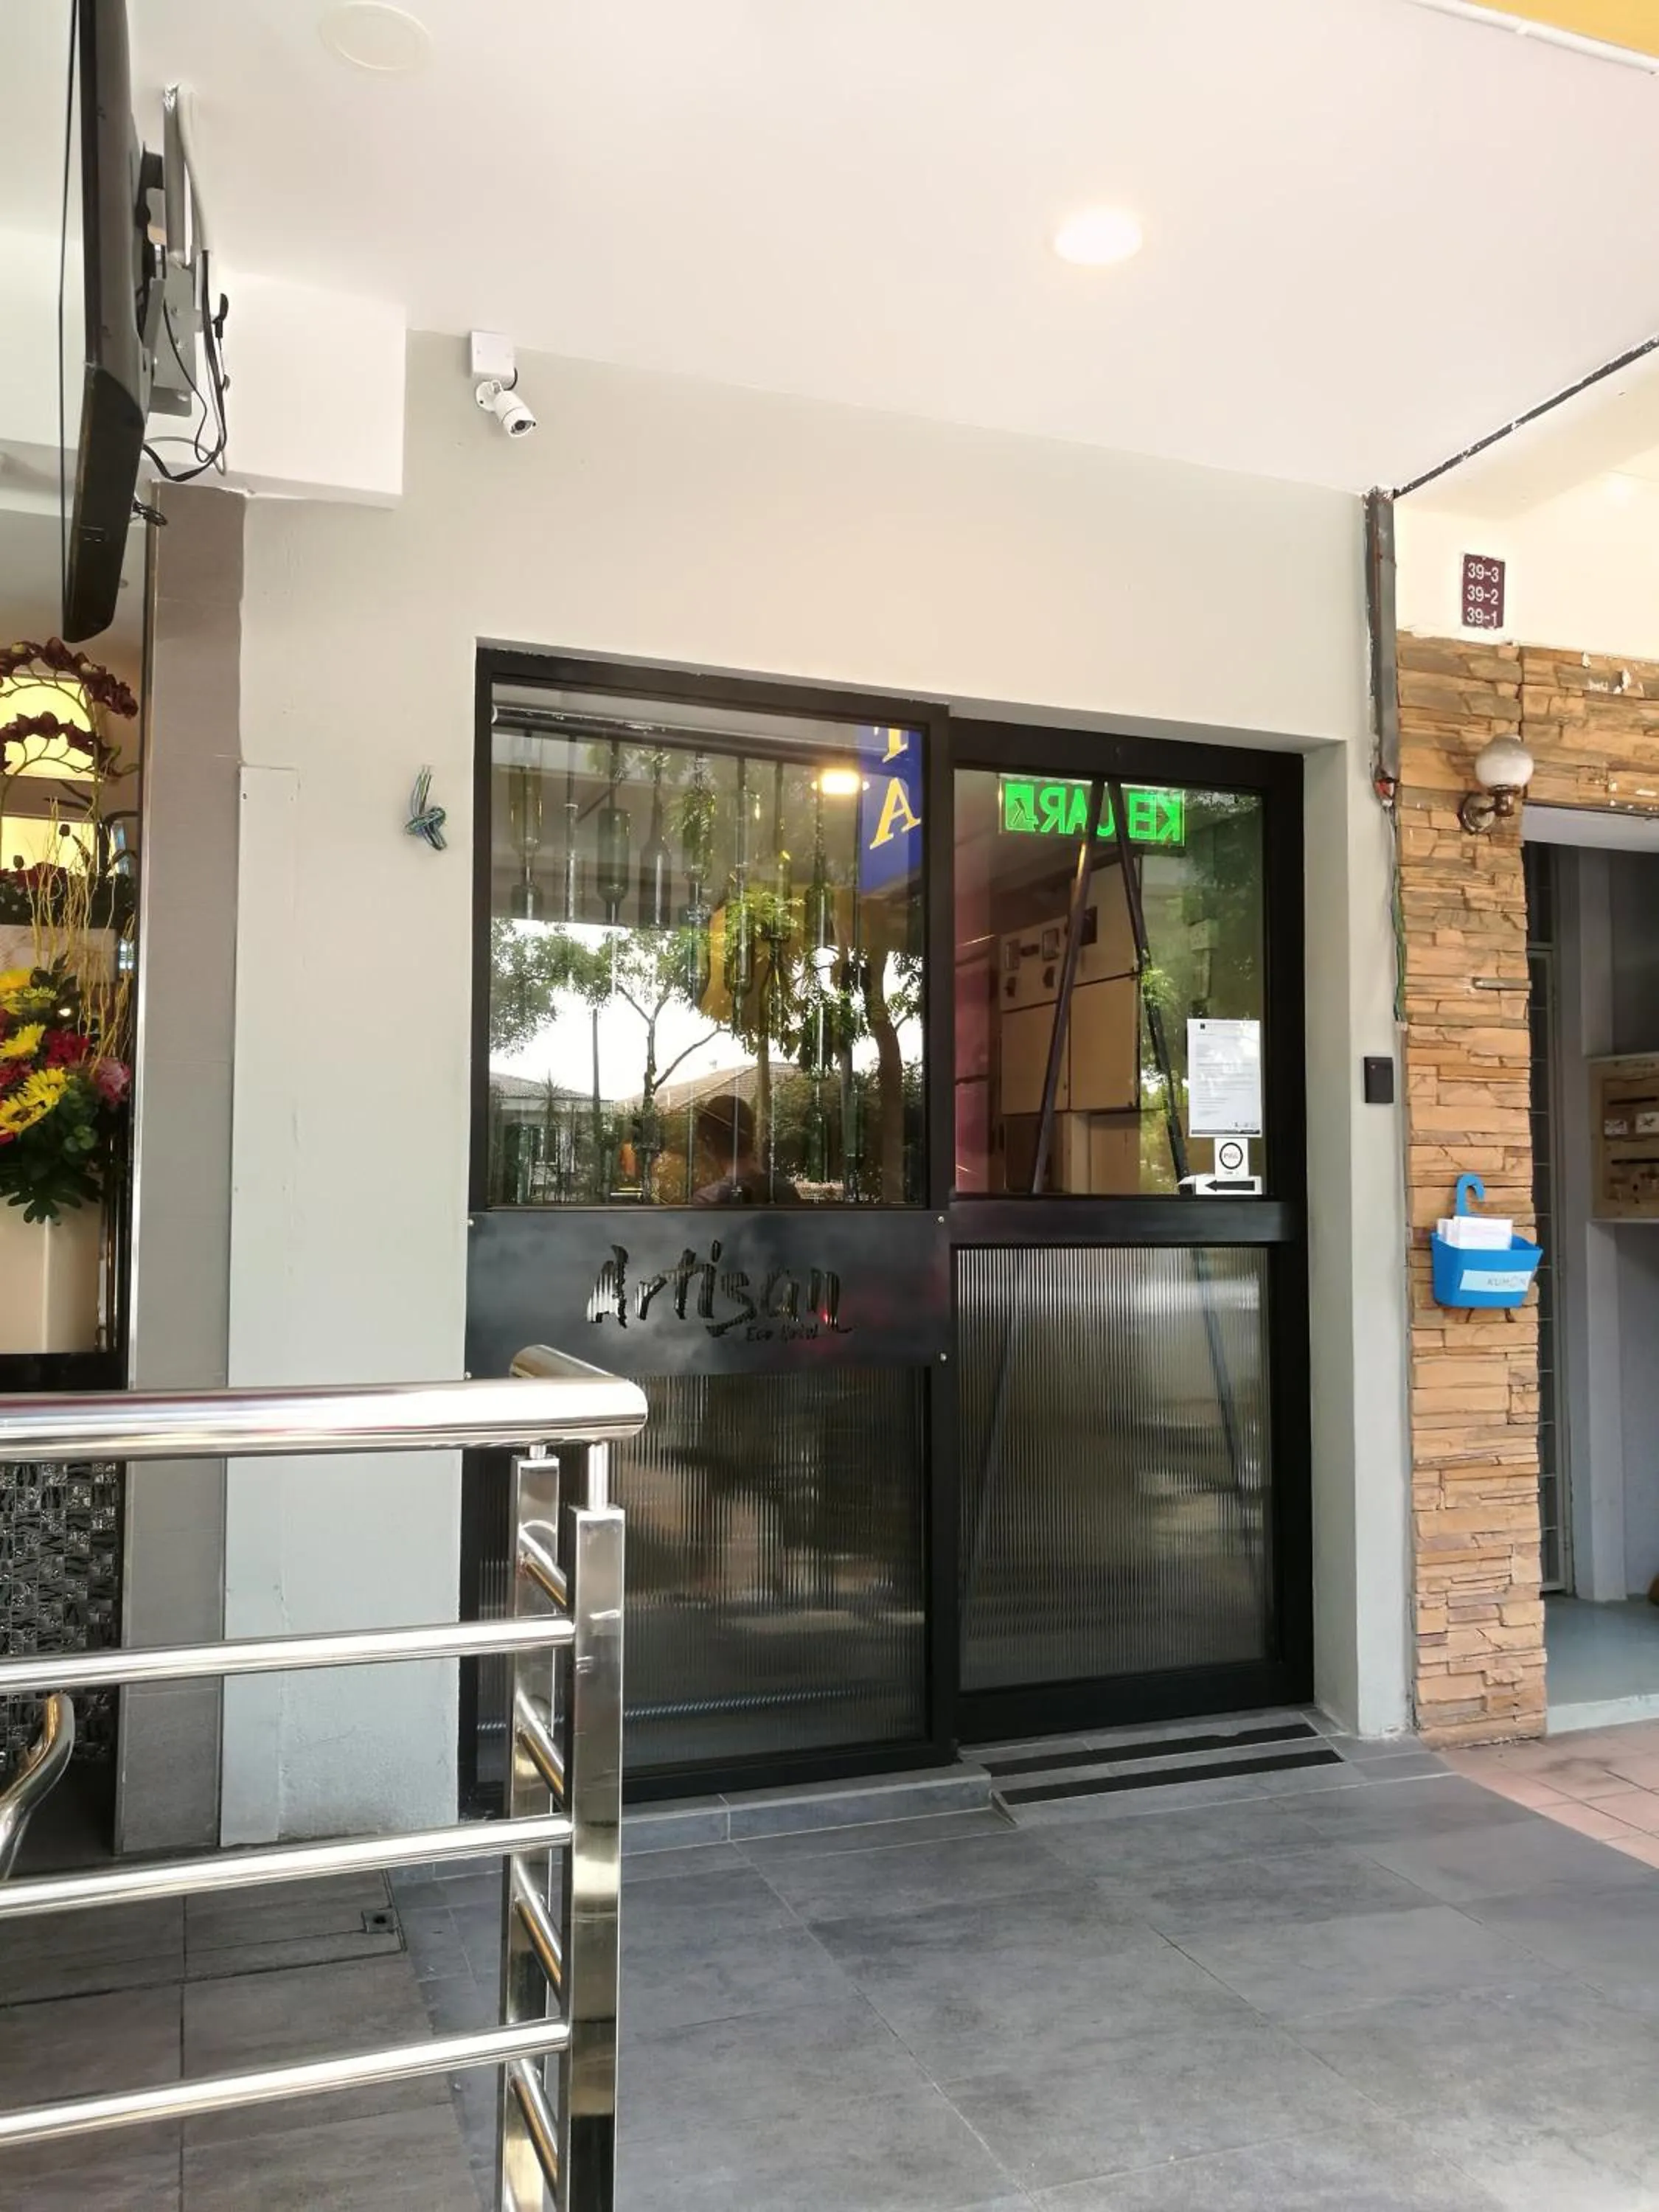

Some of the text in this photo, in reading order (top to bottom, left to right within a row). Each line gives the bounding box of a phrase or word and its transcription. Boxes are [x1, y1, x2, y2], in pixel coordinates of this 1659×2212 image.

[1468, 563, 1499, 582] 39-3
[1467, 585, 1499, 605] 39-2
[1466, 607, 1498, 627] 39-1
[586, 1240, 853, 1338] Artisan
[746, 1326, 773, 1342] Eco
